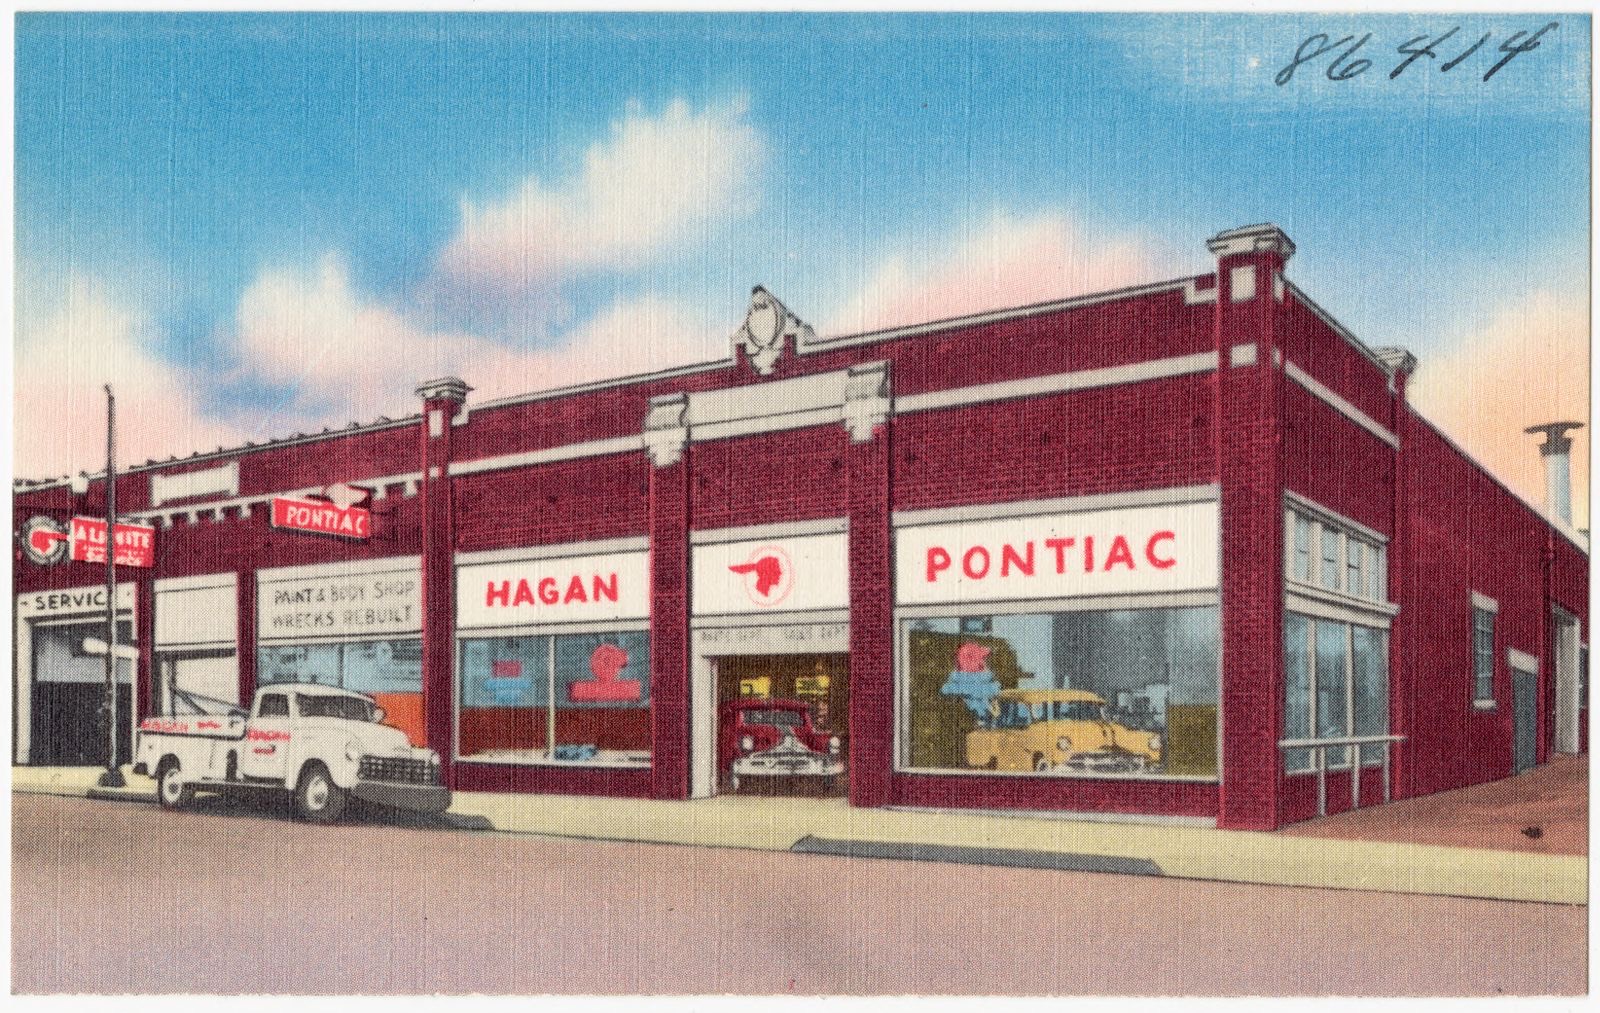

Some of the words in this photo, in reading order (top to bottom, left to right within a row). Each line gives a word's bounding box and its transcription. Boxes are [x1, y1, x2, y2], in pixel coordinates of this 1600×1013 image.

[1275, 21, 1559, 86] 86414
[286, 505, 364, 534] PONTIAC
[925, 530, 1178, 583] PONTIAC
[36, 591, 108, 610] SERVIC
[274, 588, 312, 605] PAINT
[315, 587, 326, 603] &
[330, 584, 365, 602] BODY
[374, 580, 415, 599] SHOP
[485, 572, 619, 607] HAGAN
[273, 610, 335, 629] WRECKS
[342, 604, 412, 625] REBUILT
